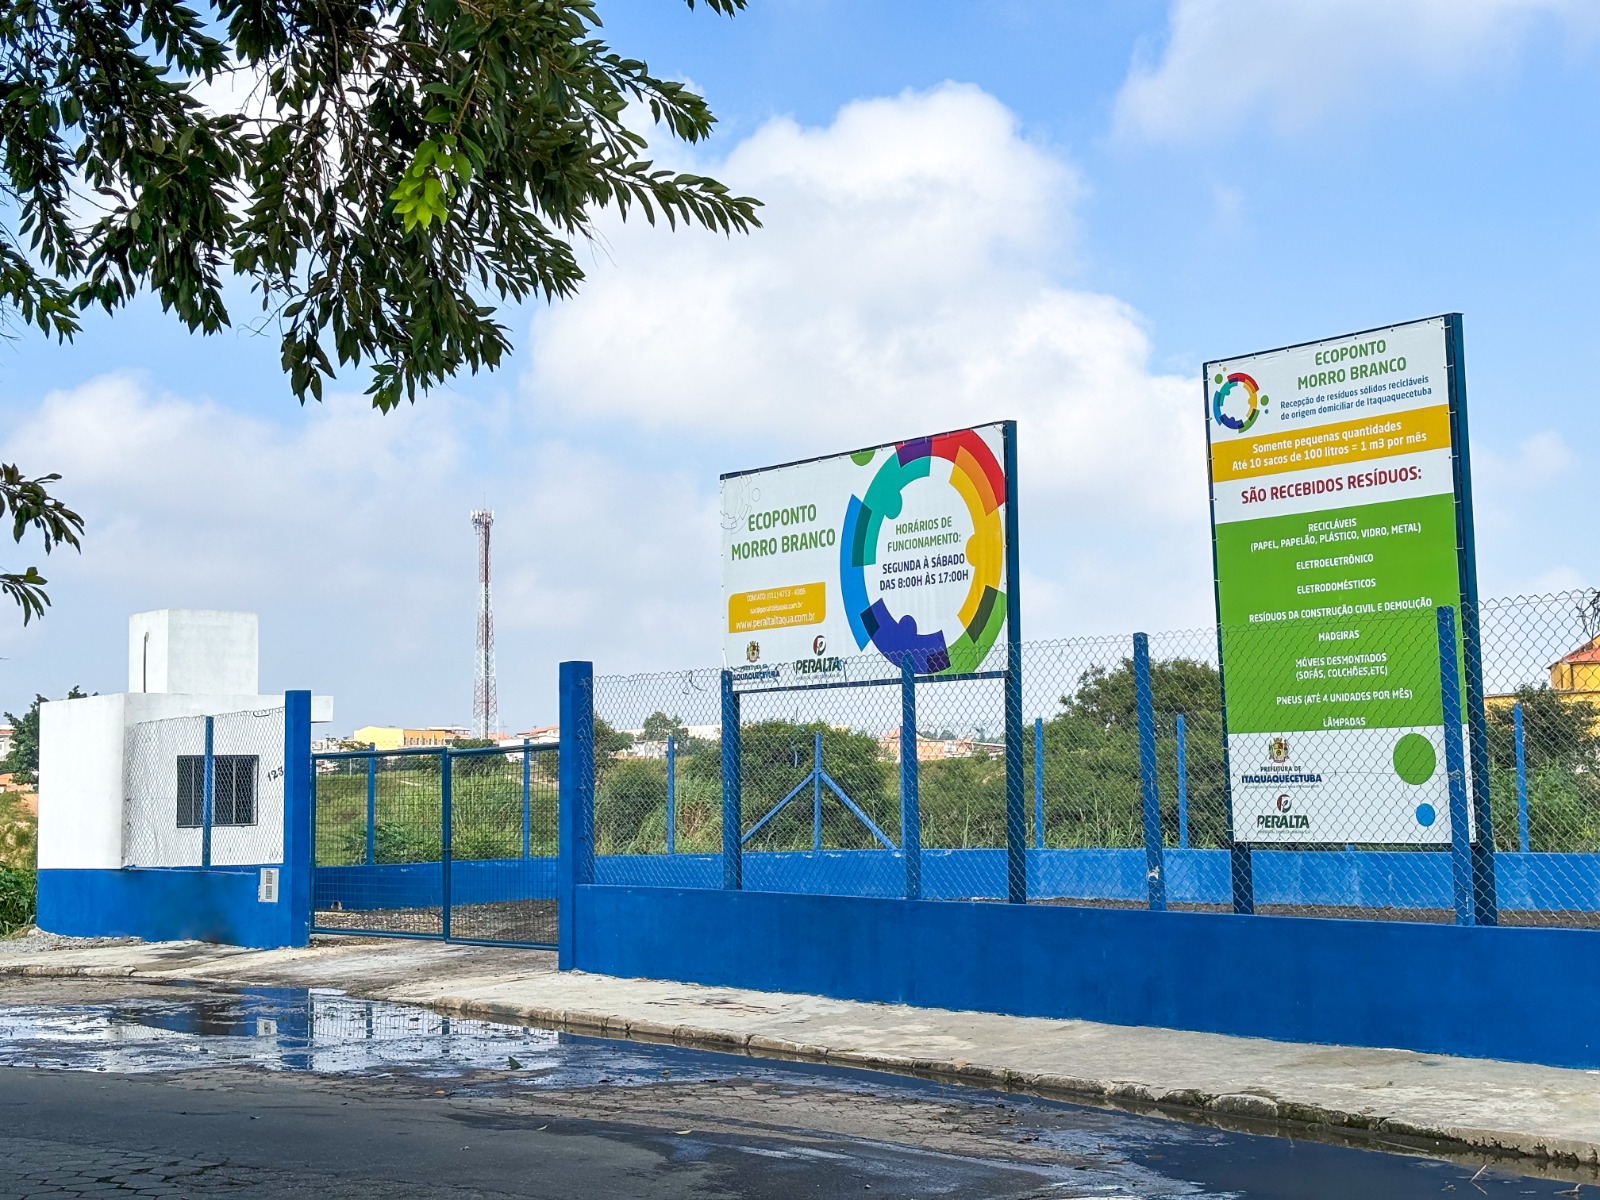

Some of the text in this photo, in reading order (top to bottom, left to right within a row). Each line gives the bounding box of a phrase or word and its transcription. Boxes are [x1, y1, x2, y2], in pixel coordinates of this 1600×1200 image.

[1315, 340, 1386, 366] ECOPONTO
[1298, 357, 1406, 390] MORRO BRANCO
[1280, 375, 1429, 410] Recepção de resíduos sólidos recicláveis
[1280, 387, 1432, 420] de origem domiciliar de Itaquaquecetuba
[1252, 421, 1402, 454] Somente pequenas quantidades
[1232, 460, 1248, 471] Até
[1250, 458, 1262, 469] 10
[1264, 454, 1288, 466] sacos
[1290, 452, 1302, 462] de
[1304, 448, 1323, 461] 100
[1324, 445, 1349, 458] litros
[1360, 440, 1366, 451] 1
[1369, 438, 1384, 450] m3
[1388, 436, 1404, 450] por
[1406, 432, 1426, 444] mês
[1241, 466, 1422, 504] SÃO RECEBIDOS RESÍDUOS:
[748, 504, 817, 532] ECOPONTO
[895, 516, 952, 536] HORÁRIOS DE
[1308, 518, 1357, 532] RECICLÁVEIS
[731, 528, 836, 561] MORRO BRANCO
[887, 532, 962, 553] FUNCIONAMENTO:
[1250, 522, 1421, 553] (PAPEL, PAPELÃO, PLÁSTICO, VIDRO, METAL)
[882, 552, 965, 574] SEGUNDA À SÁBADO
[1296, 553, 1374, 570] ELETROELETRÔNICO
[880, 570, 969, 591] DAS 8:00H ÀS 17:00H
[1297, 578, 1376, 594] ELETRODOMÉSTICOS
[1250, 598, 1432, 622] RESÍDUOS DA CONSTRUÇÃO CIVIL E DEMOLIÇÃO
[1318, 630, 1360, 641] MADEIRAS
[795, 657, 840, 674] PERALTA
[1296, 653, 1387, 668] MÓVEIS DESMONTADOS
[1276, 694, 1302, 705] PNEUS
[1304, 693, 1321, 705] (ATÉ
[1331, 692, 1370, 702] UNIDADES
[1373, 690, 1390, 700] POR
[1392, 688, 1412, 700] MÊS)
[1323, 717, 1366, 727] LÂMPADAS
[1242, 774, 1322, 784] ITAQUAQUECETUBA
[1257, 815, 1310, 828] PERALTA
